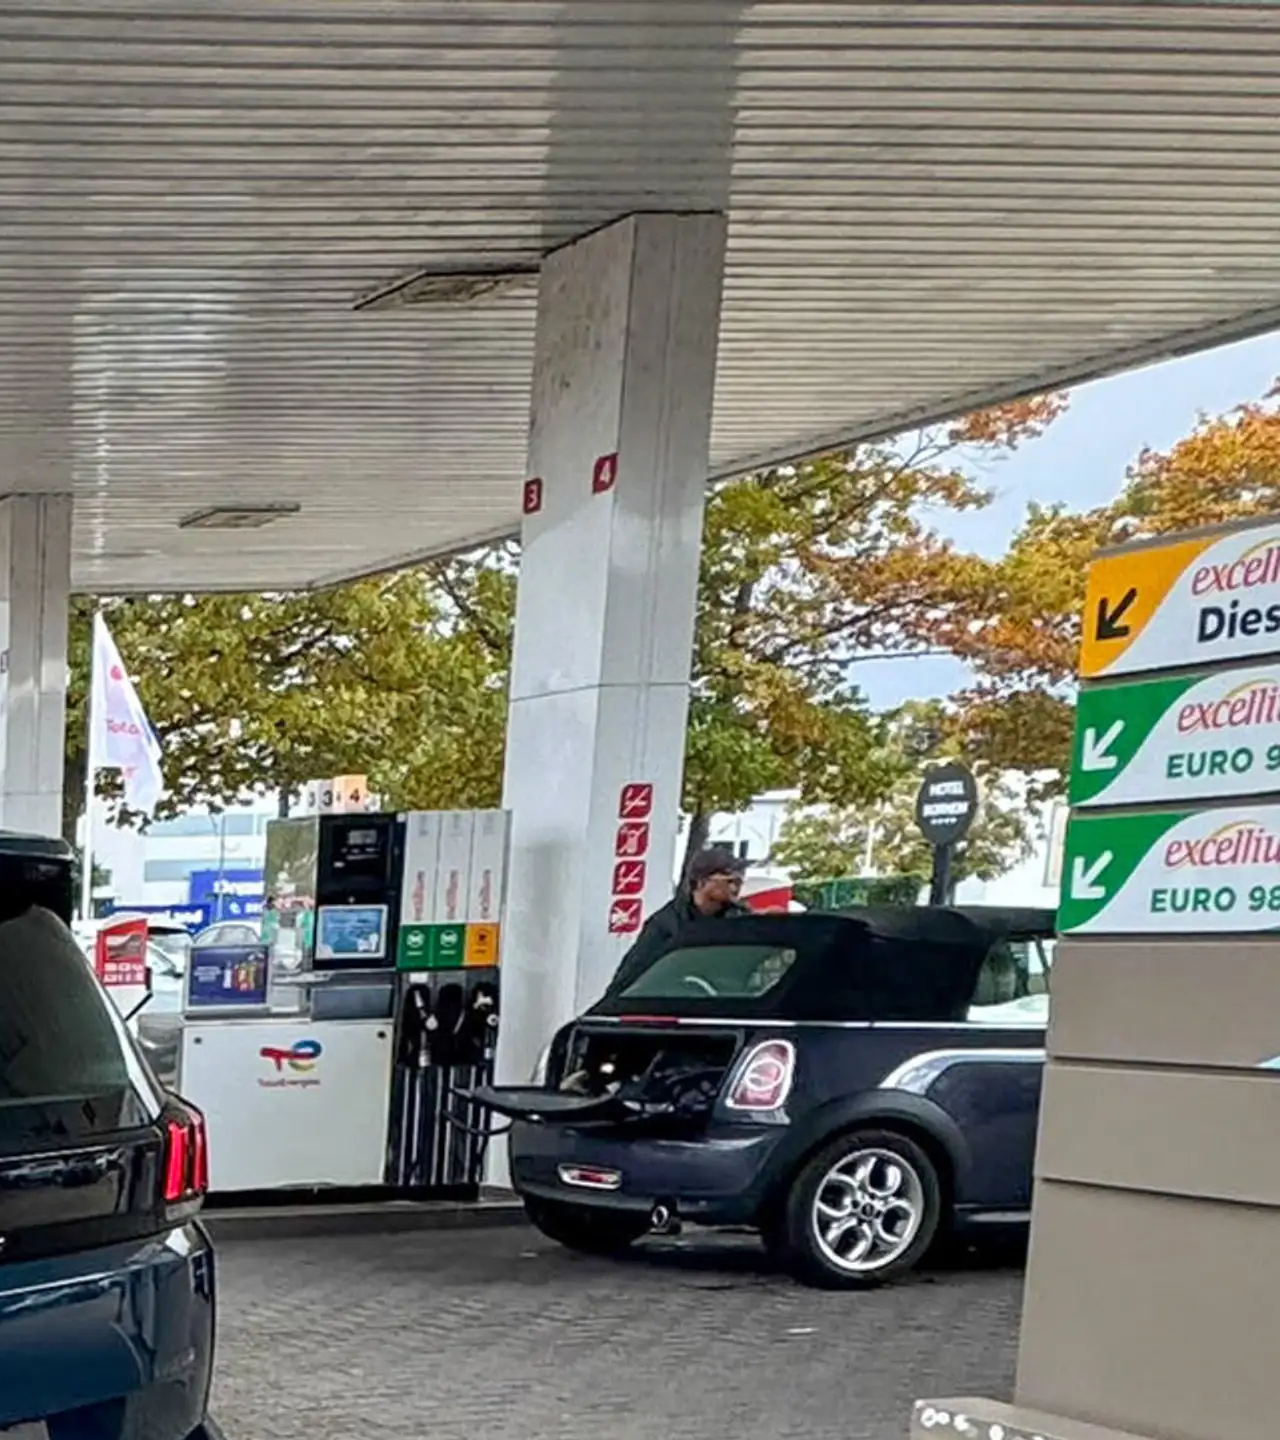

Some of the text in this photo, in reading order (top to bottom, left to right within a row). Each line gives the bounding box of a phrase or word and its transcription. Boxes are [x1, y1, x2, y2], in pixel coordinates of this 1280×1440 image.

[598, 459, 613, 483] 4
[526, 483, 539, 510] 3
[1197, 598, 1280, 643] Dies
[1166, 747, 1254, 779] EURO
[322, 789, 333, 808] 3
[349, 788, 360, 803] 4
[1150, 884, 1280, 913] EURO 98
